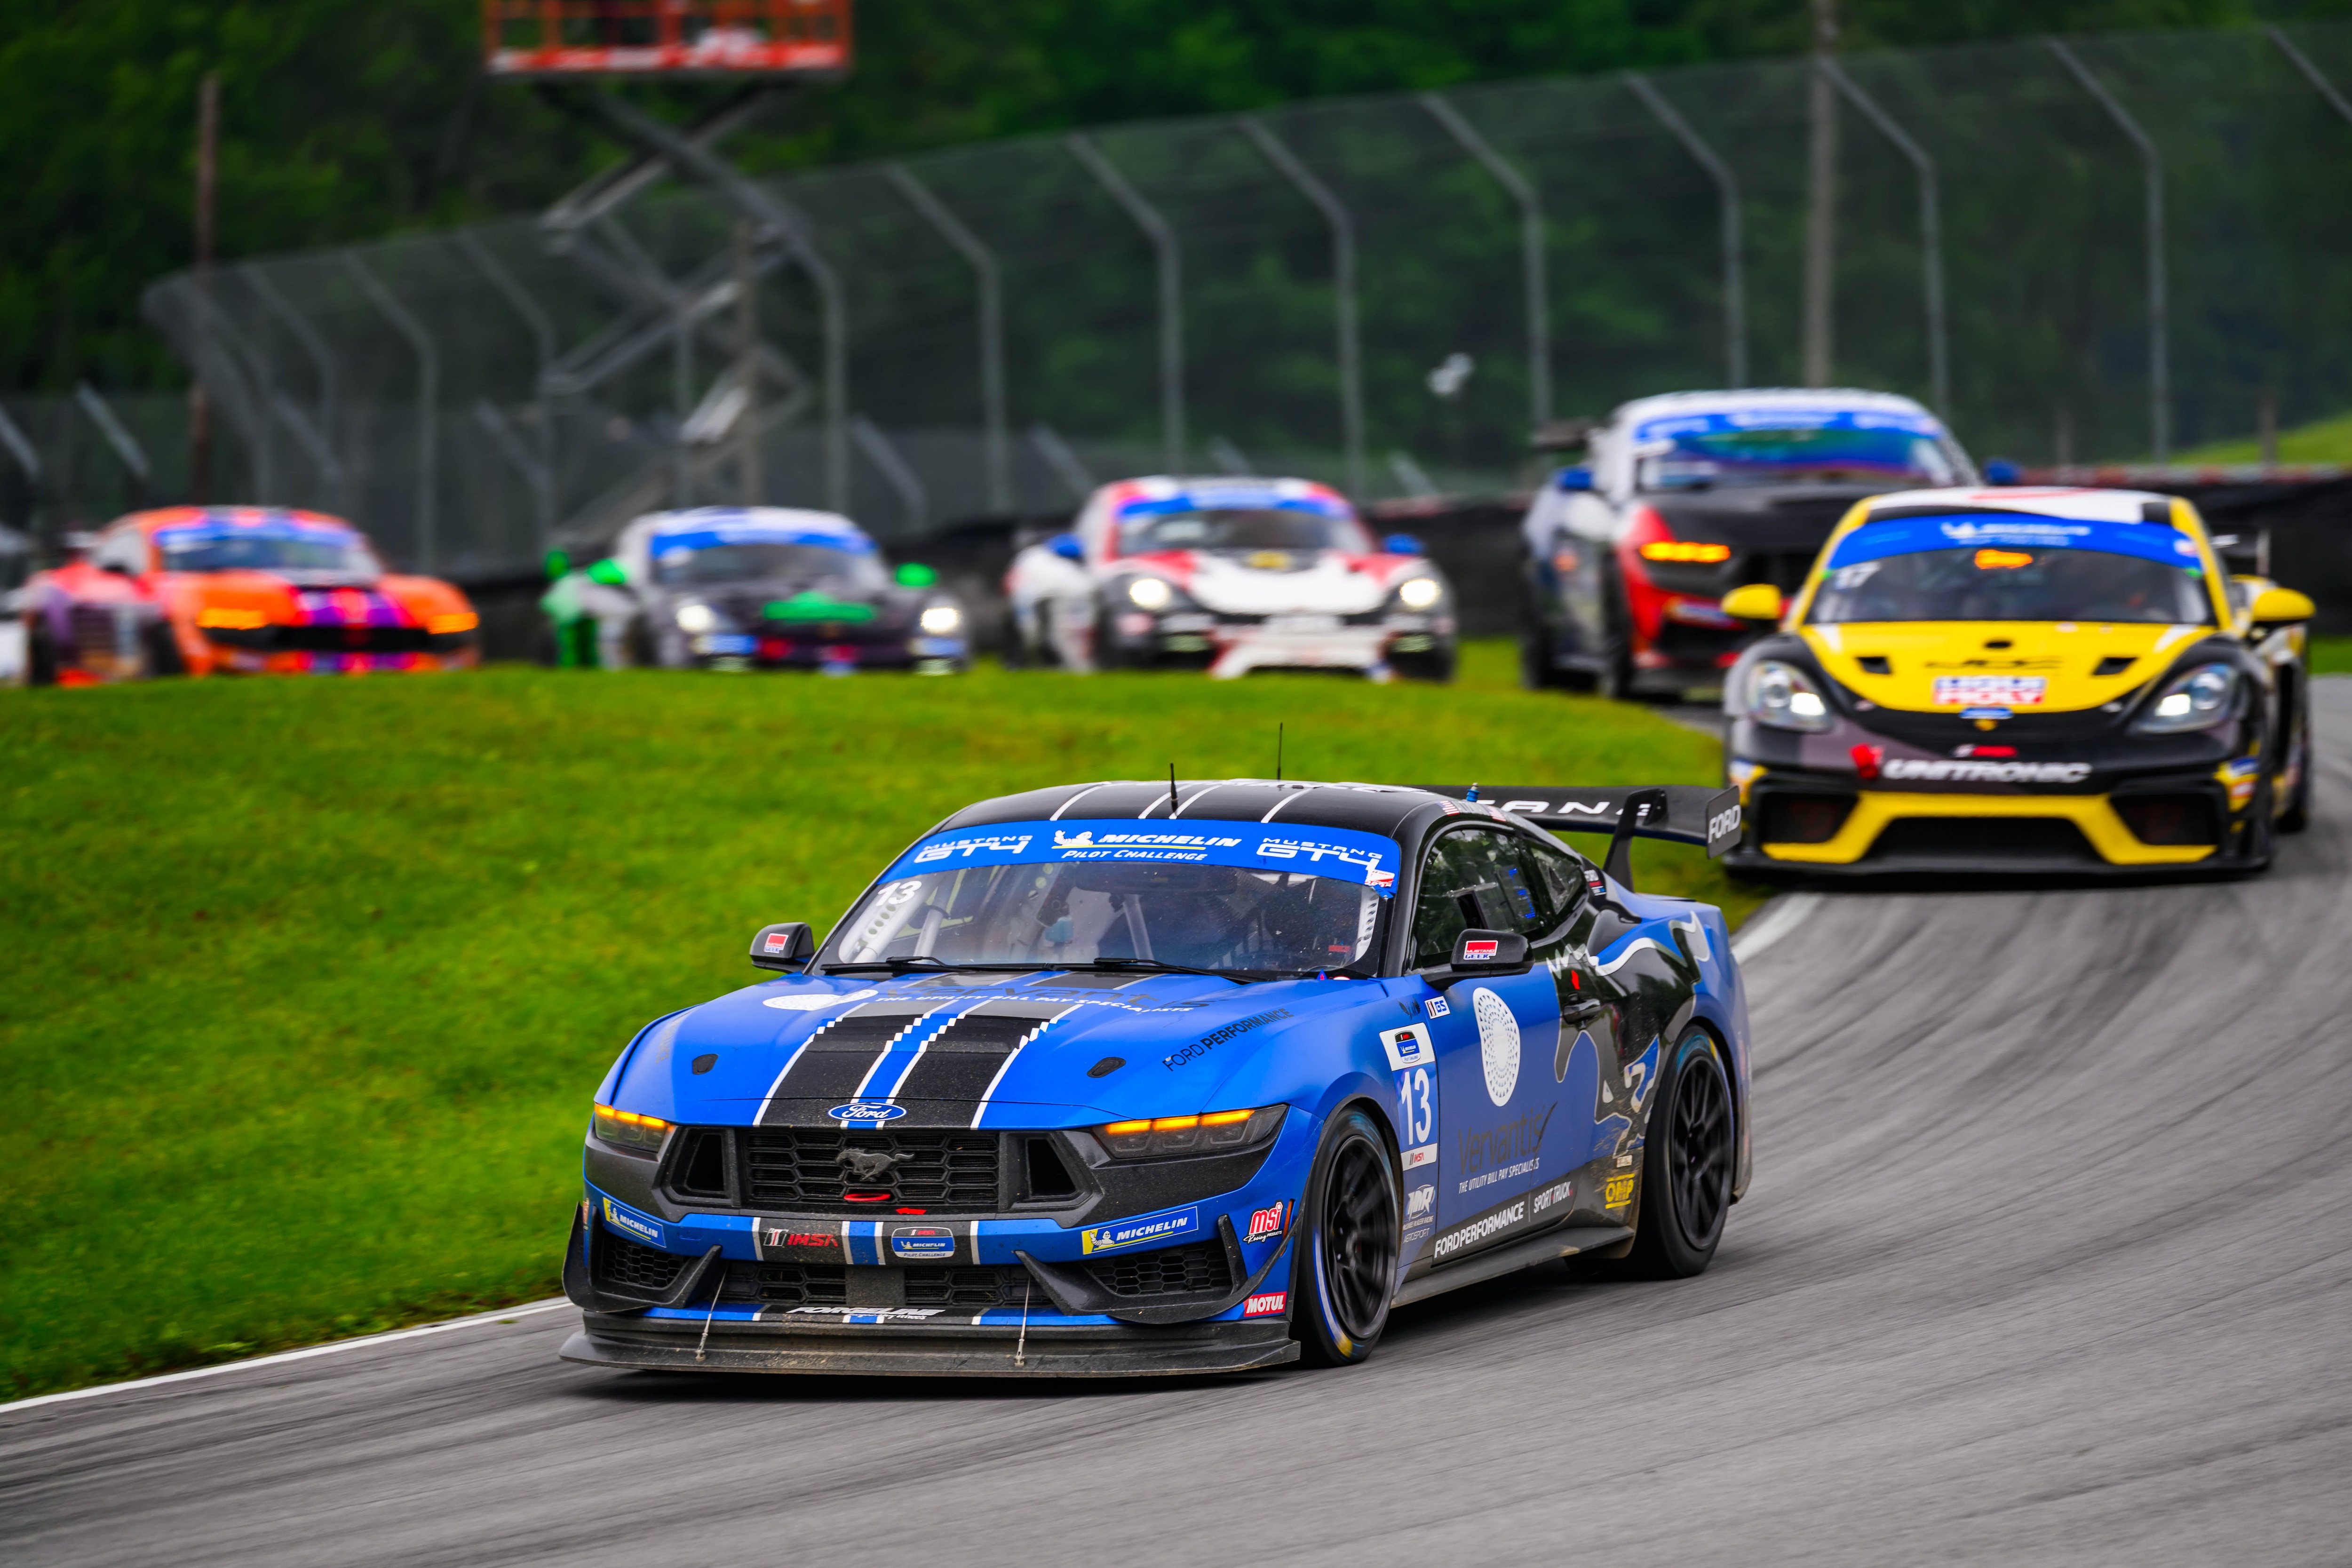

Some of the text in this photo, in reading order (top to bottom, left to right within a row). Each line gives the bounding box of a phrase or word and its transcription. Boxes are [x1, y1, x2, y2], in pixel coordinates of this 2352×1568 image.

[1708, 804, 1741, 844] FORD
[914, 840, 1030, 863] GT4
[923, 835, 1033, 851] MUSTANG
[1098, 834, 1242, 847] MICHELIN
[1263, 837, 1383, 860] MUSTANG
[1061, 849, 1208, 861] PILOT CHALLENGE
[1256, 843, 1380, 871] GT4
[875, 880, 922, 907] 13
[1074, 999, 1194, 1013] SPECIALISTS
[1434, 1000, 1447, 1013] GS
[1162, 1008, 1295, 1072] FORD PERFORMANCE
[841, 1104, 892, 1118] Ford
[1401, 1068, 1431, 1146] 13
[1459, 1106, 1543, 1175] Vervantis
[1414, 1152, 1424, 1163] IMSA
[1459, 1157, 1540, 1194] THE UTILITY BILL PAY SPECIALISTS
[1533, 1181, 1571, 1214] SPORT TRUCK
[1605, 1179, 1634, 1202] OMP
[620, 1214, 658, 1238] MICHELIN
[1116, 1217, 1188, 1241] MICHELIN
[787, 1233, 838, 1247] IMSA
[1243, 1234, 1266, 1244] Racing
[786, 1307, 946, 1316] FORGELINE
[1246, 1295, 1284, 1314] MOTUL
